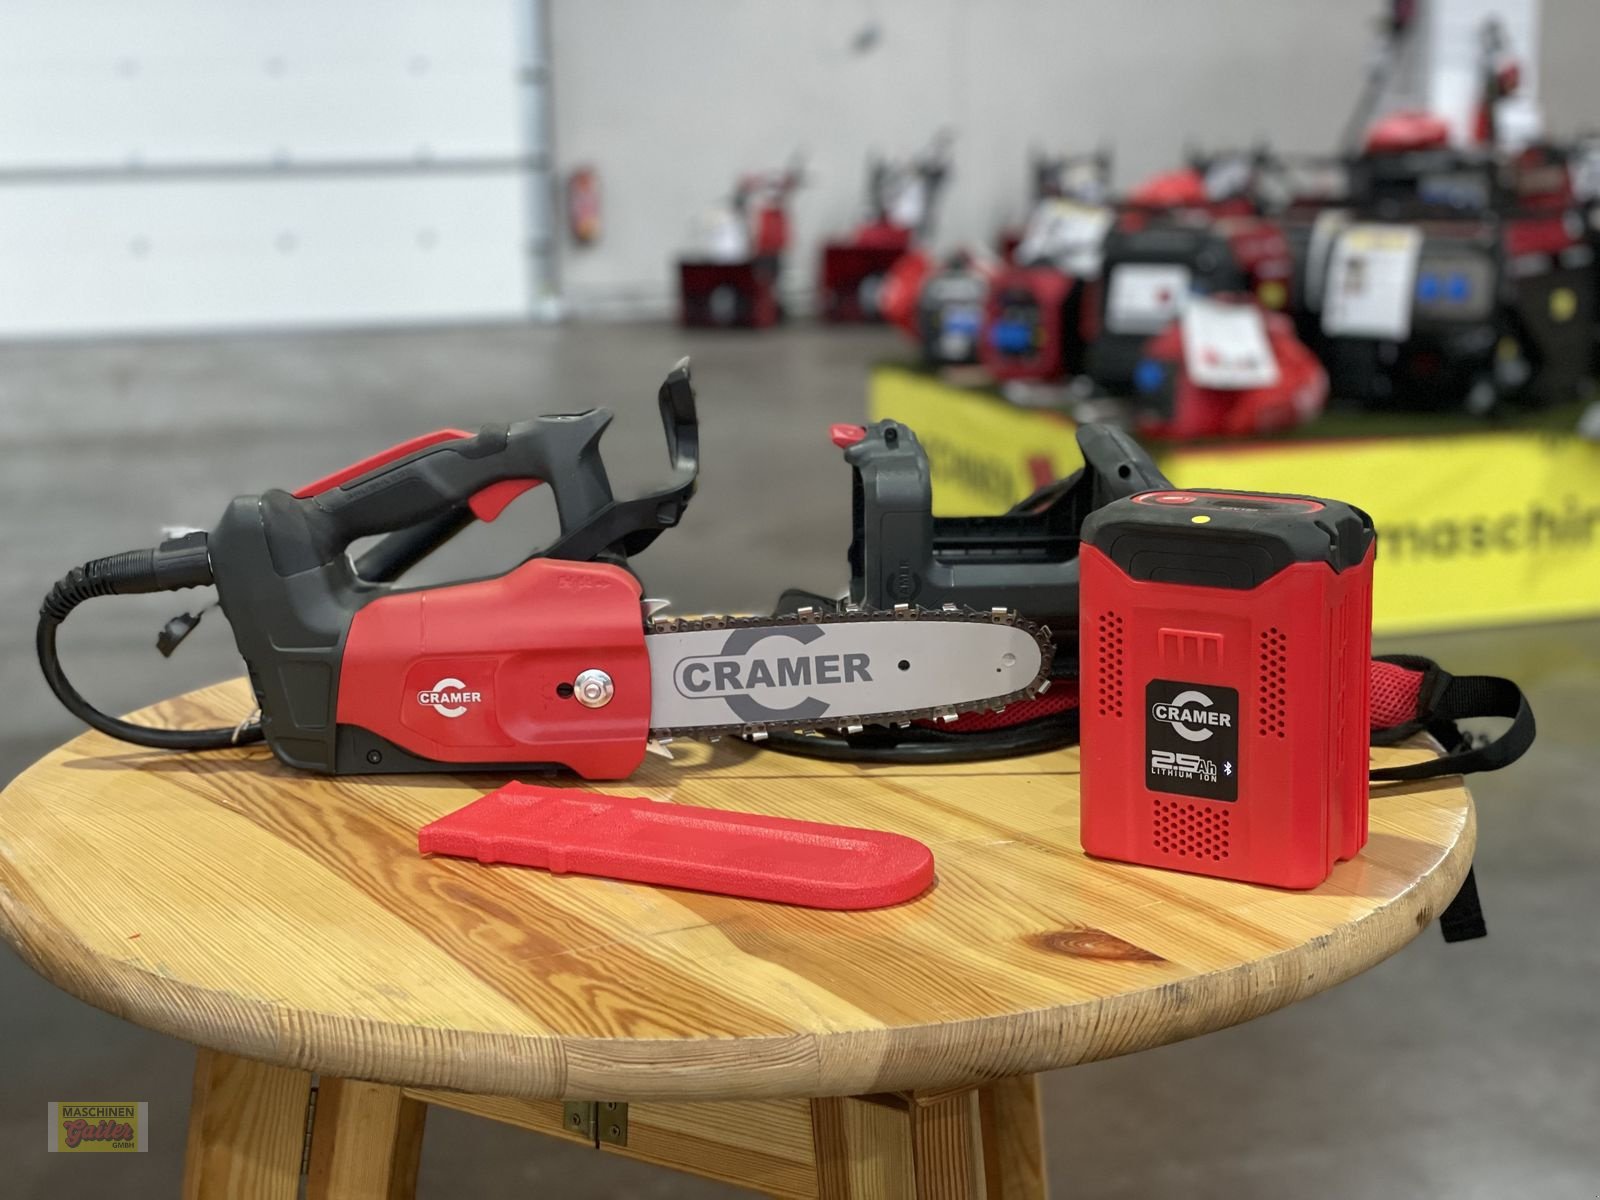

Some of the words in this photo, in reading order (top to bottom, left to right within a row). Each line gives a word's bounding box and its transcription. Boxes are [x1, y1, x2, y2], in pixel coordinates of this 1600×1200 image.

[682, 653, 874, 693] CRAMER
[419, 692, 481, 704] CRAMER
[1155, 705, 1231, 728] CRAMER
[1151, 767, 1193, 779] LITHIUM
[1199, 774, 1217, 783] ION
